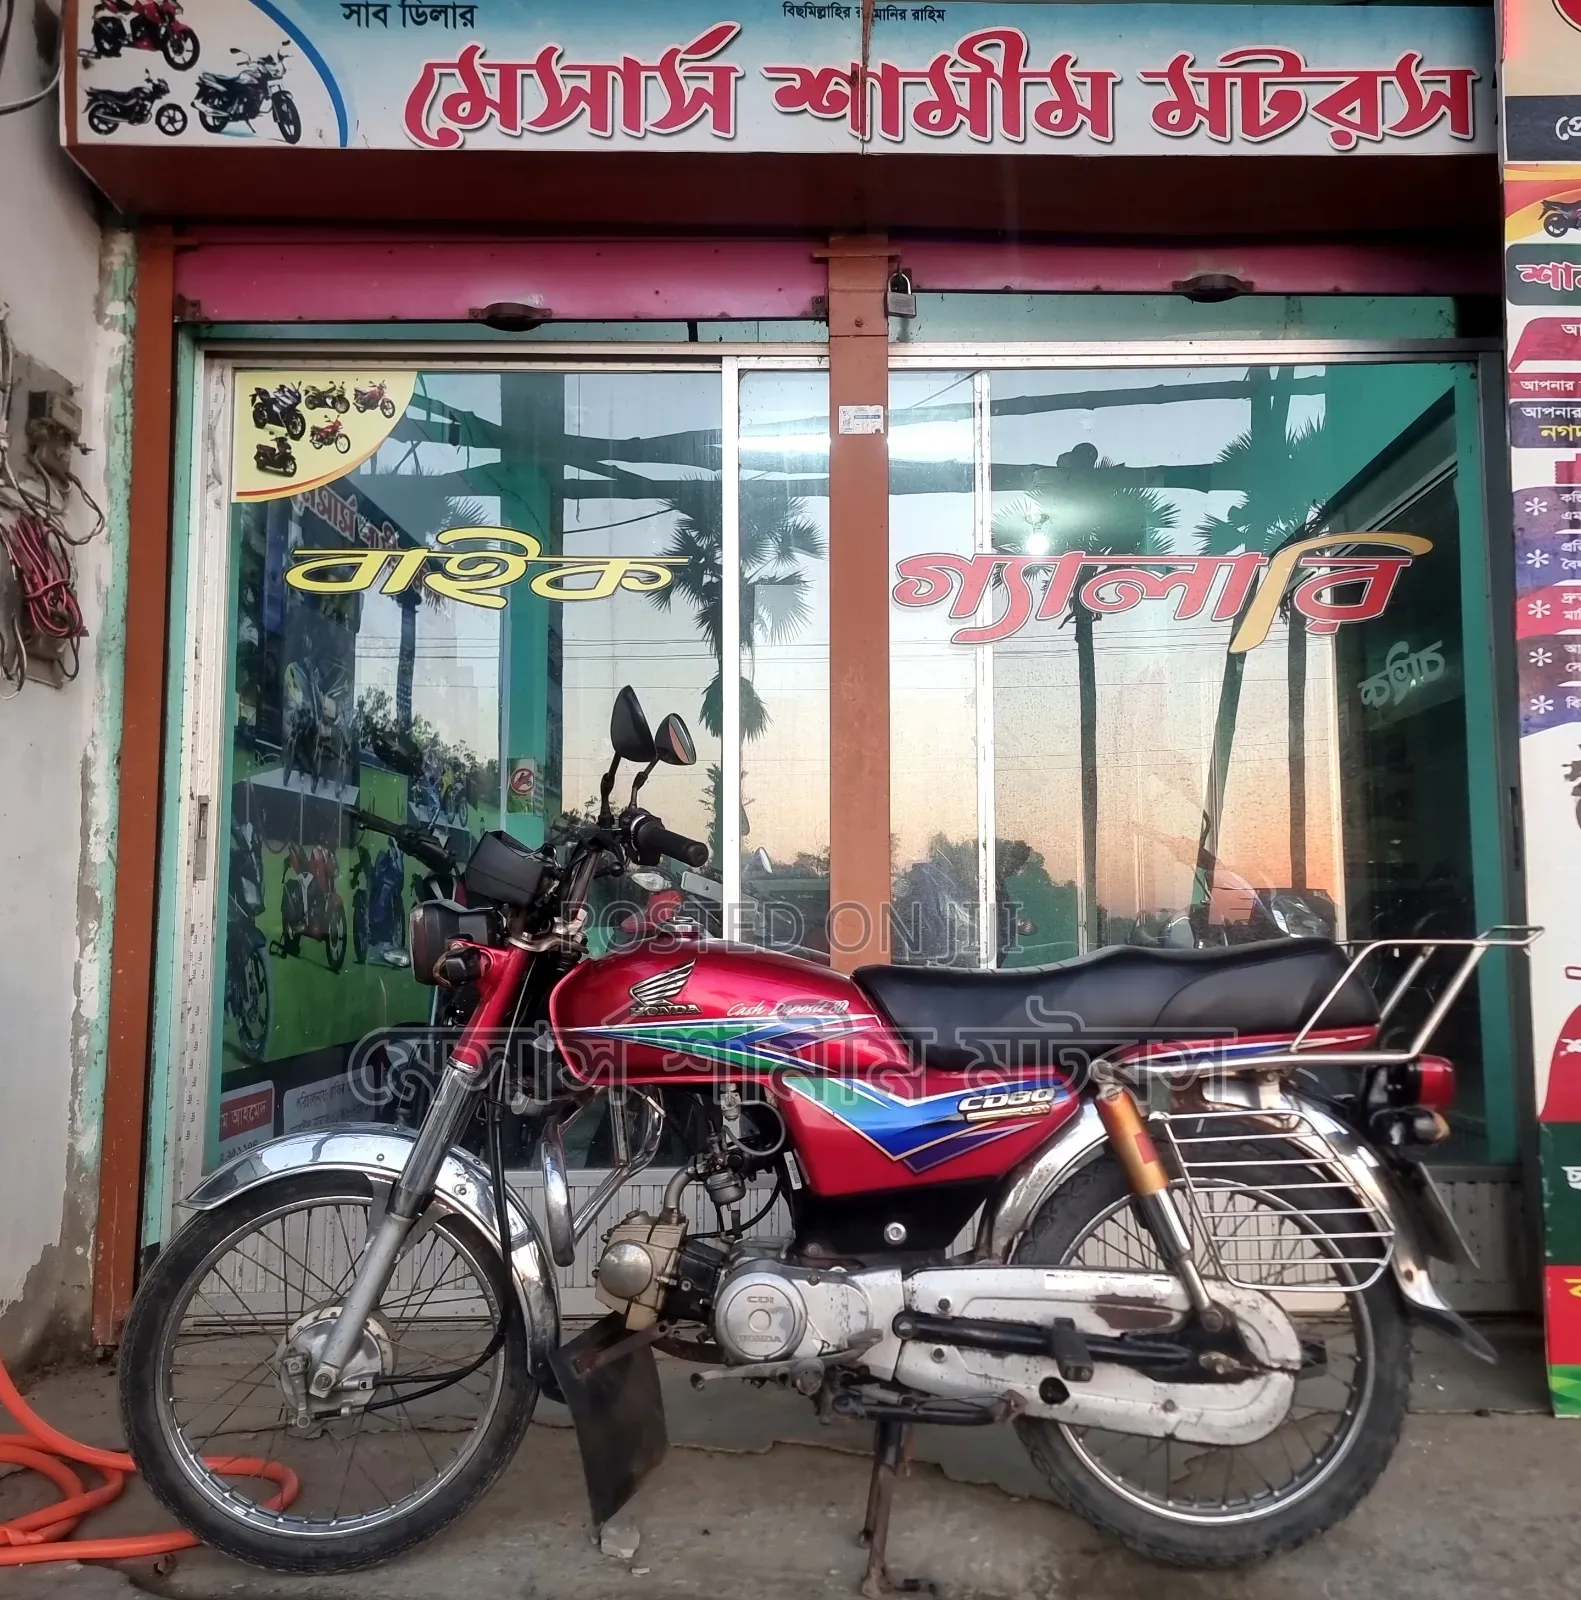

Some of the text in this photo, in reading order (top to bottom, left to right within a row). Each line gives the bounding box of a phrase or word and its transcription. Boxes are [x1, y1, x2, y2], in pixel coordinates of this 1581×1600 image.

[340, 0, 480, 29] সাব ডিলার
[911, 9, 947, 22] রাহিম
[401, 21, 1482, 151] মেসার্স শামীম মটরস
[1520, 380, 1576, 391] আপনার
[285, 525, 693, 611] বাইক
[891, 531, 1435, 655] গ্যালারি
[630, 1004, 702, 1017] HONDA
[727, 1000, 850, 1019] Cash Deposit 80
[958, 1087, 1055, 1111] CD80
[746, 1296, 774, 1304] CDI
